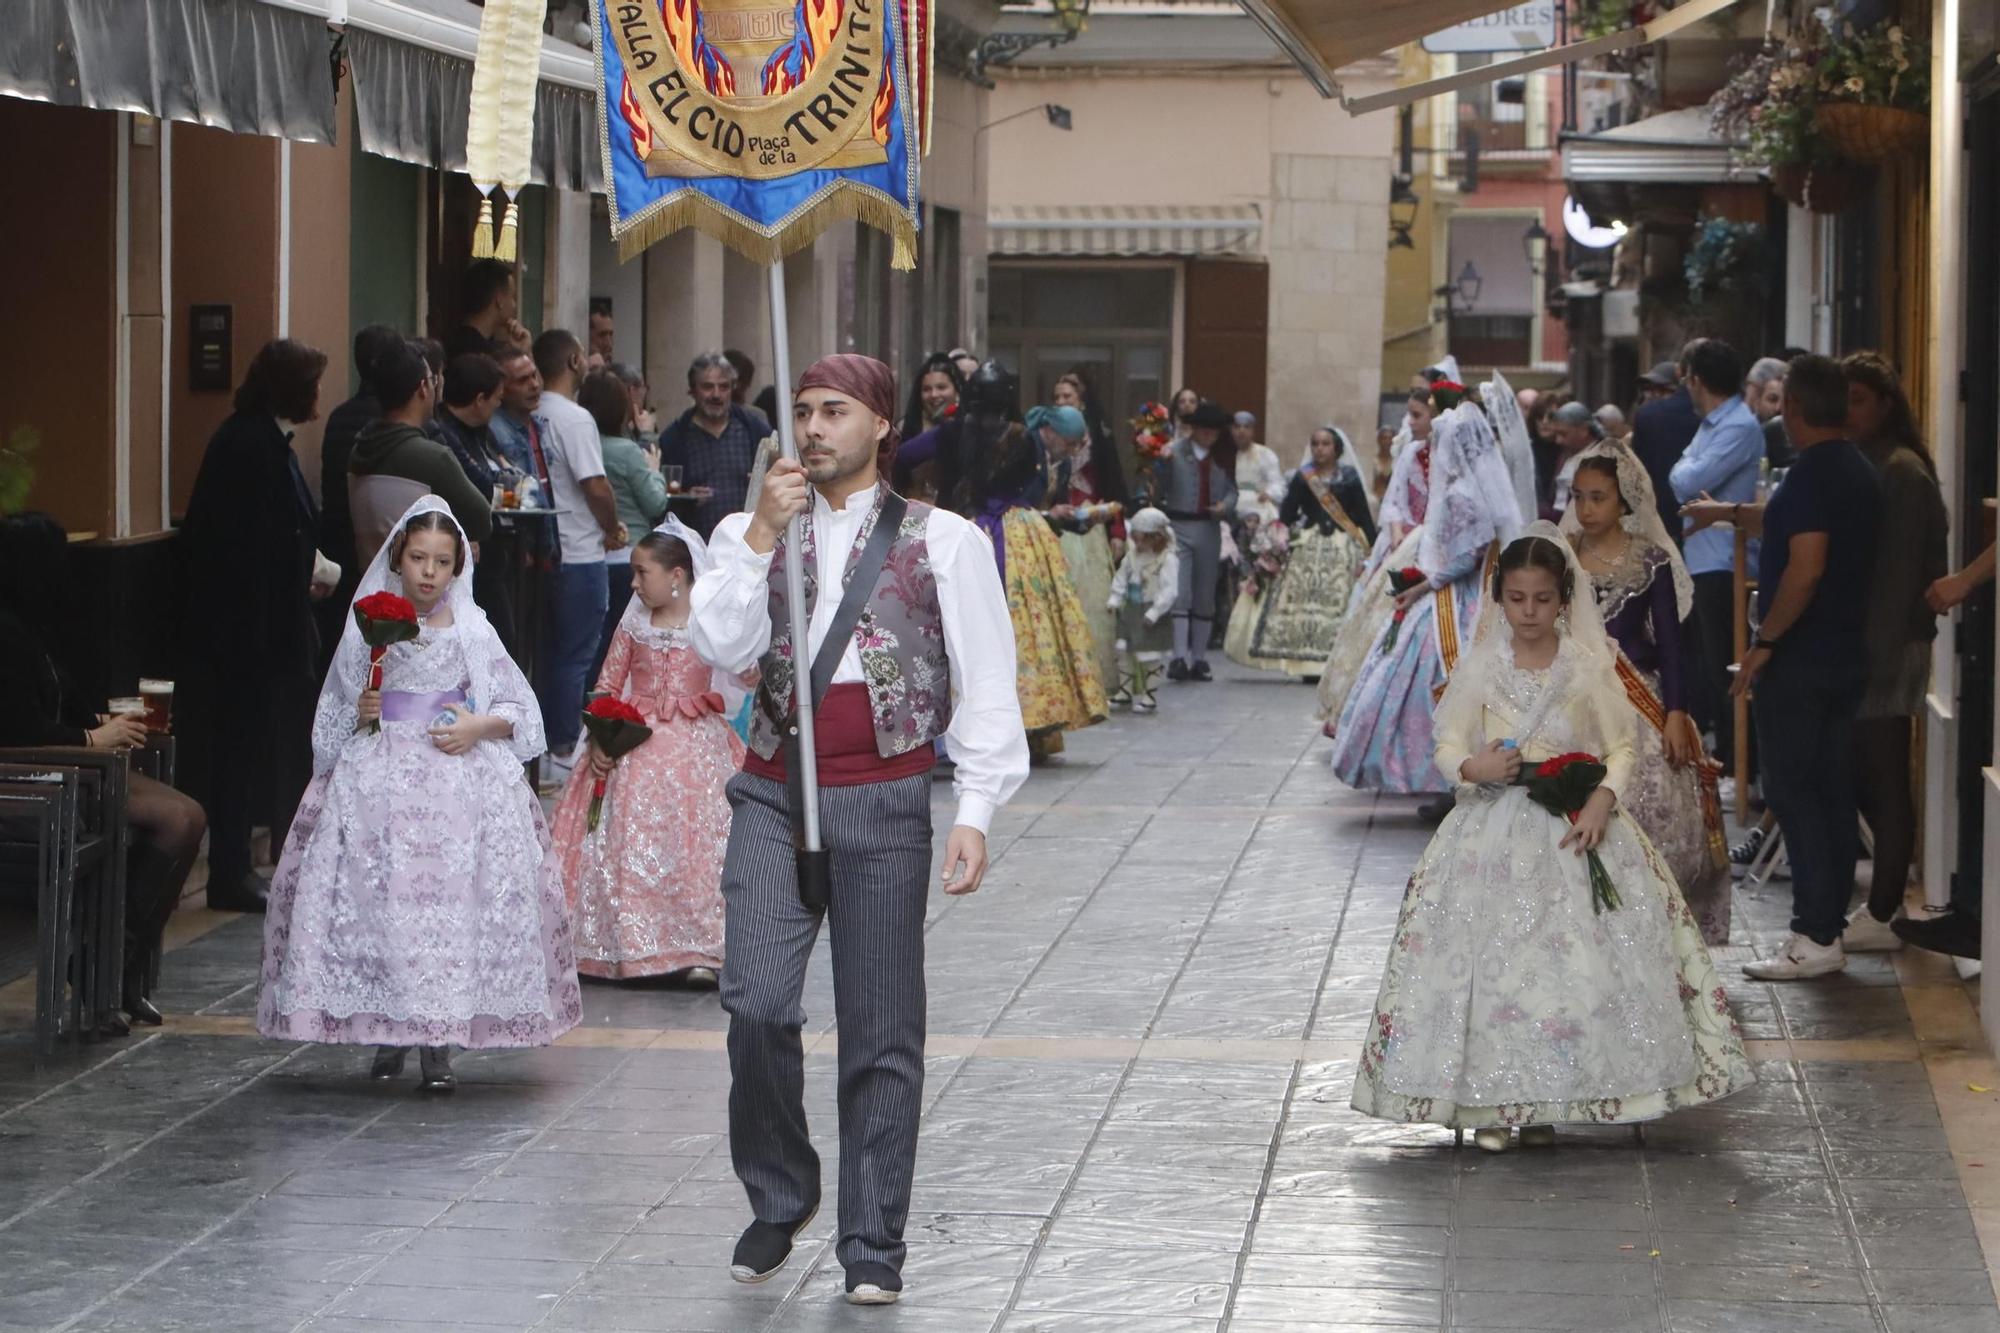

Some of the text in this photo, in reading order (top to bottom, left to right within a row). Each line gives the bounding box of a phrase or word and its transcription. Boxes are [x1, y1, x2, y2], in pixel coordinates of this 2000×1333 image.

[617, 0, 745, 159] ALLA EL CID
[748, 136, 790, 153] Plaça
[759, 150, 796, 166] de la
